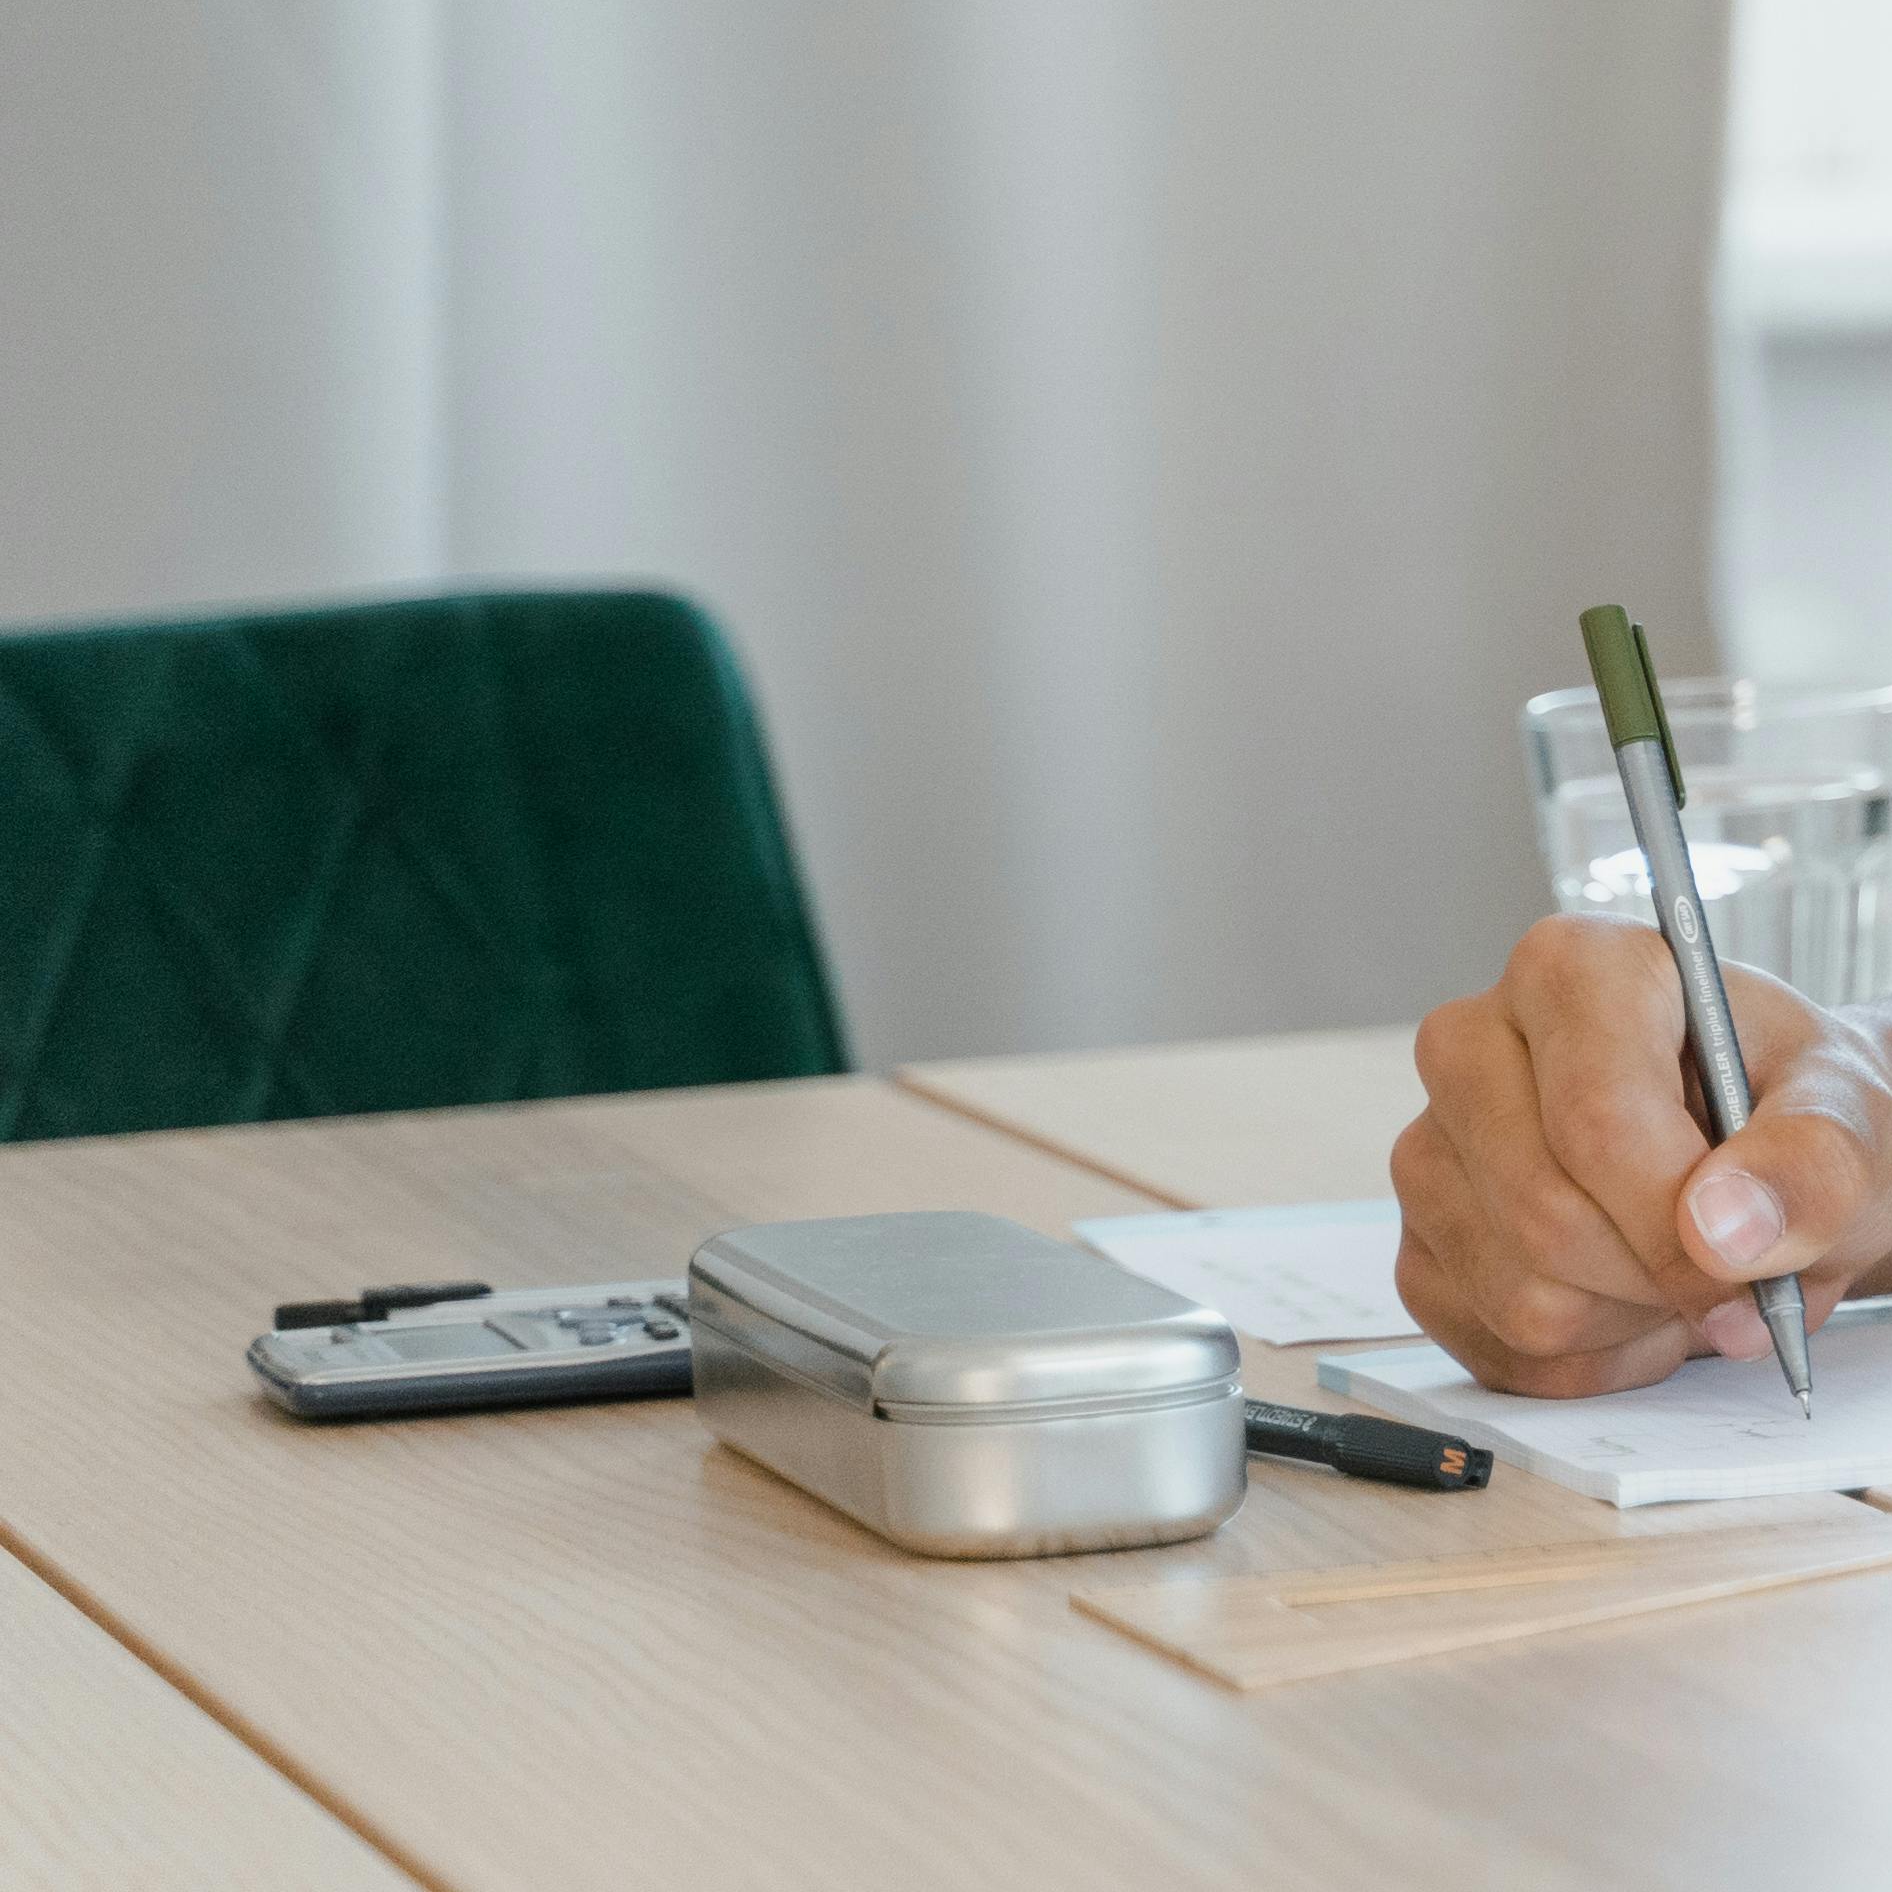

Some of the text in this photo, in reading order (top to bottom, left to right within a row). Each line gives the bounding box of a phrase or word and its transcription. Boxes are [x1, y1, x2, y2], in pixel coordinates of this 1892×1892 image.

[1691, 950, 1746, 1130] STAEDTLER triplus fineliner
[1245, 1404, 1303, 1428] STAEDTLE
[1440, 1448, 1467, 1475] M
